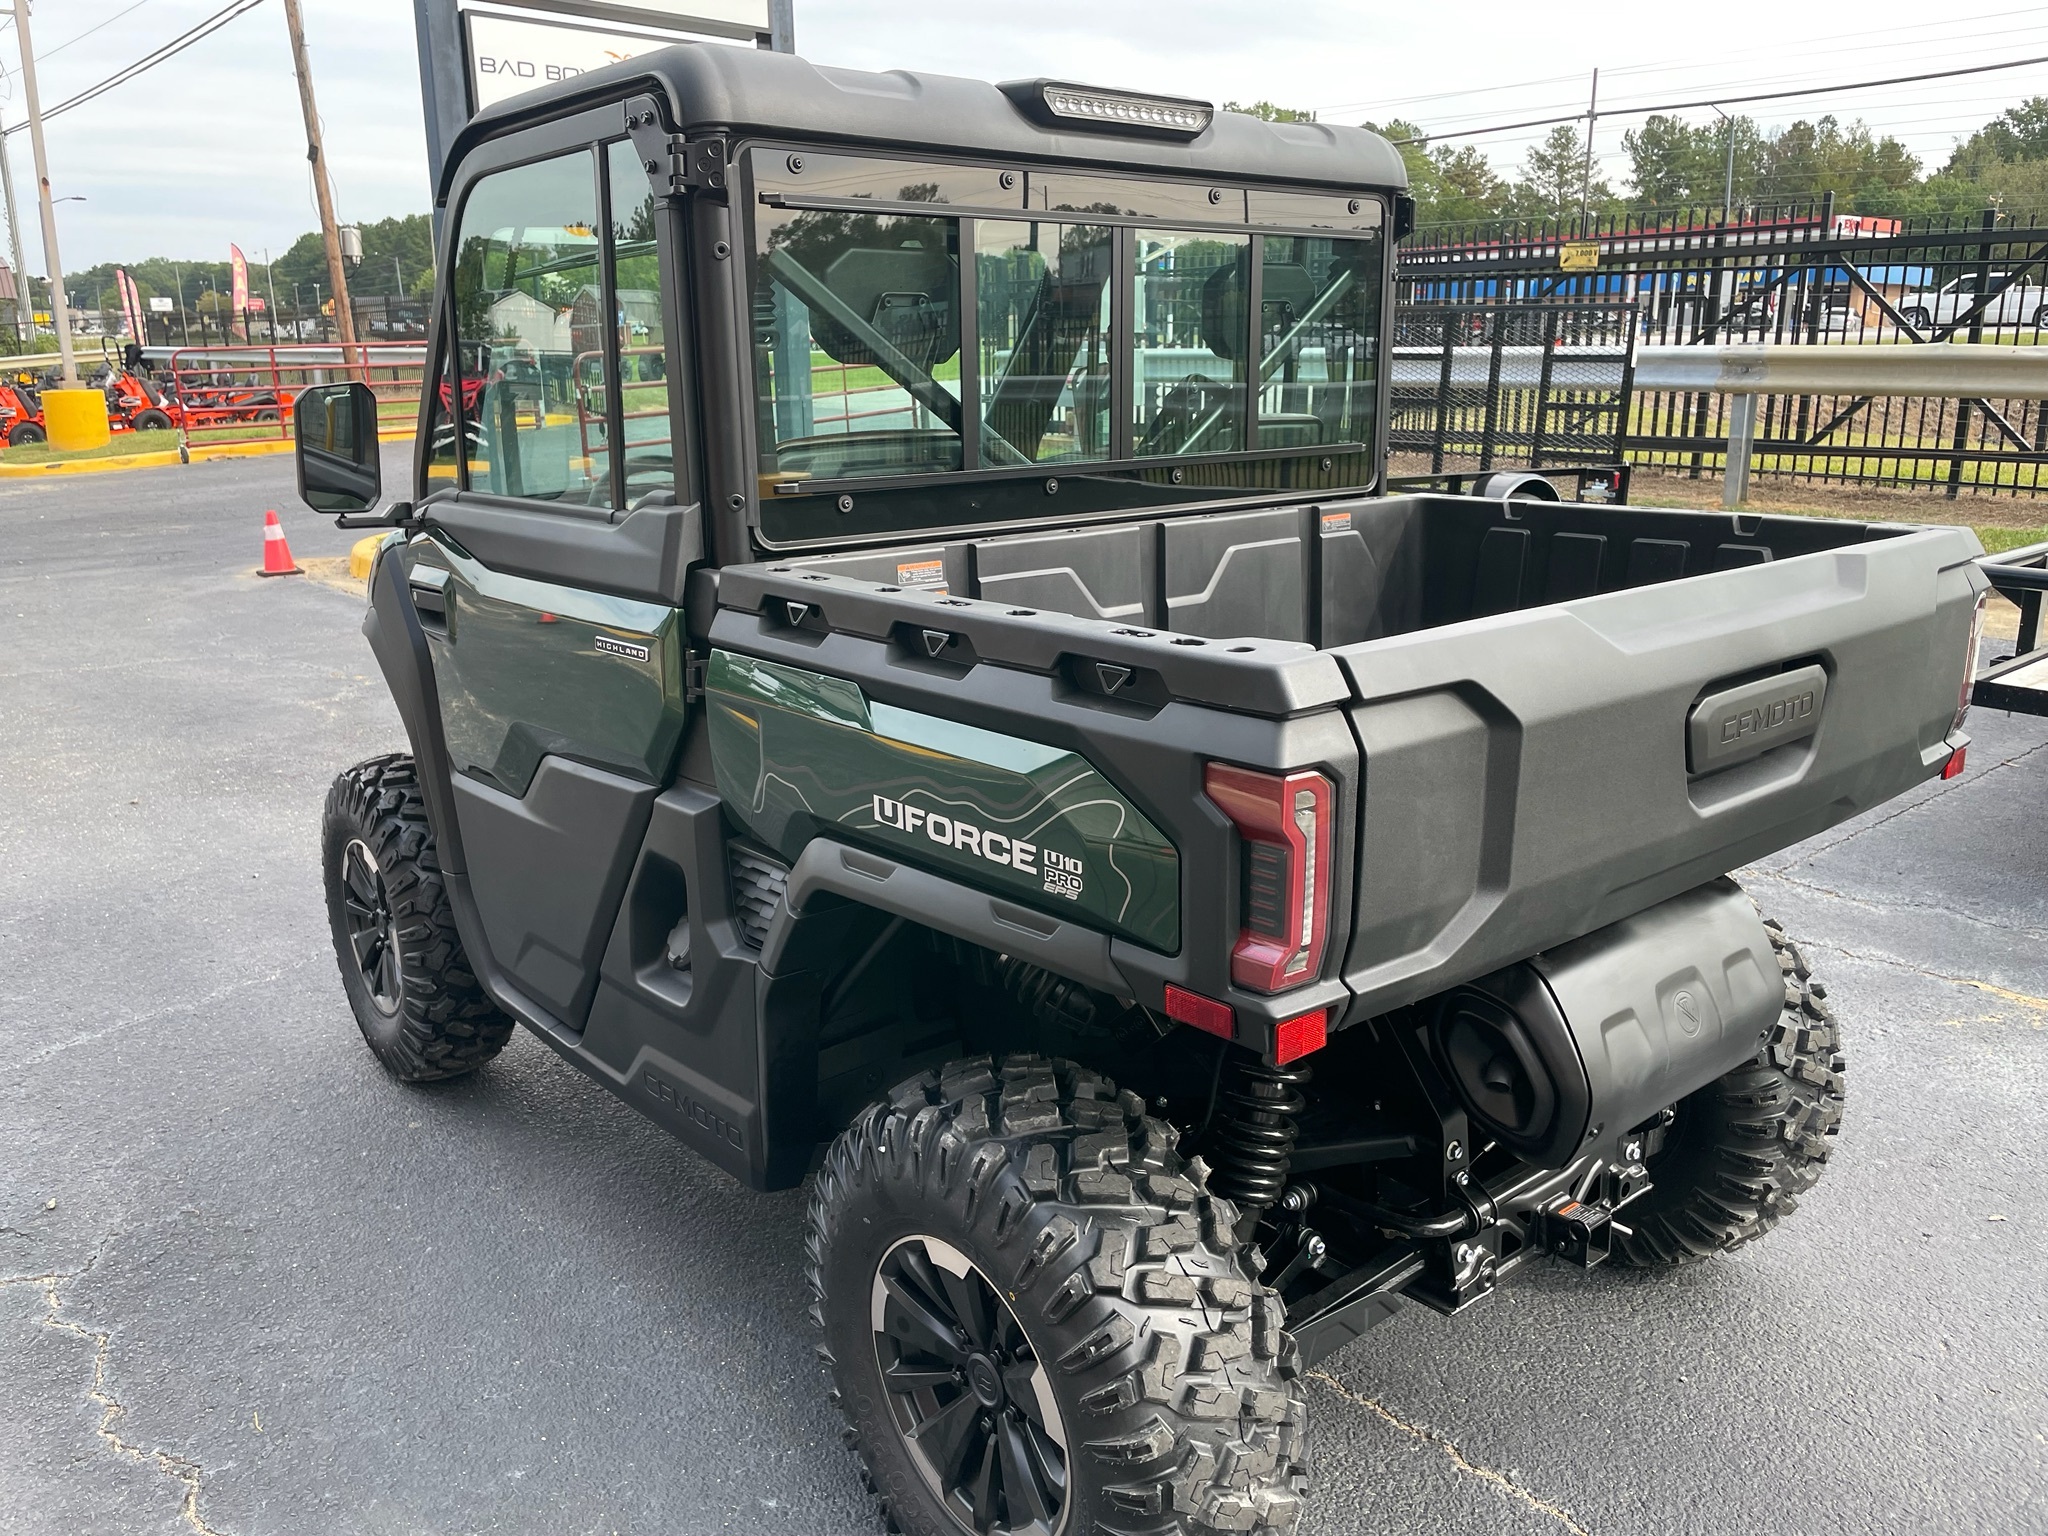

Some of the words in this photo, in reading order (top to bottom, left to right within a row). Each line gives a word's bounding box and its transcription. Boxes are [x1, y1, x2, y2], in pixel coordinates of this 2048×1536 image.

[480, 57, 535, 78] BAD
[546, 64, 587, 81] BO
[596, 641, 645, 658] HIGHLAND
[1721, 691, 1814, 744] CFMOTO
[873, 794, 1038, 875] UFORCE
[1043, 849, 1083, 875] U10
[1043, 882, 1079, 901] EPS
[1044, 866, 1083, 892] PRO
[643, 1070, 744, 1152] CFMOTO
